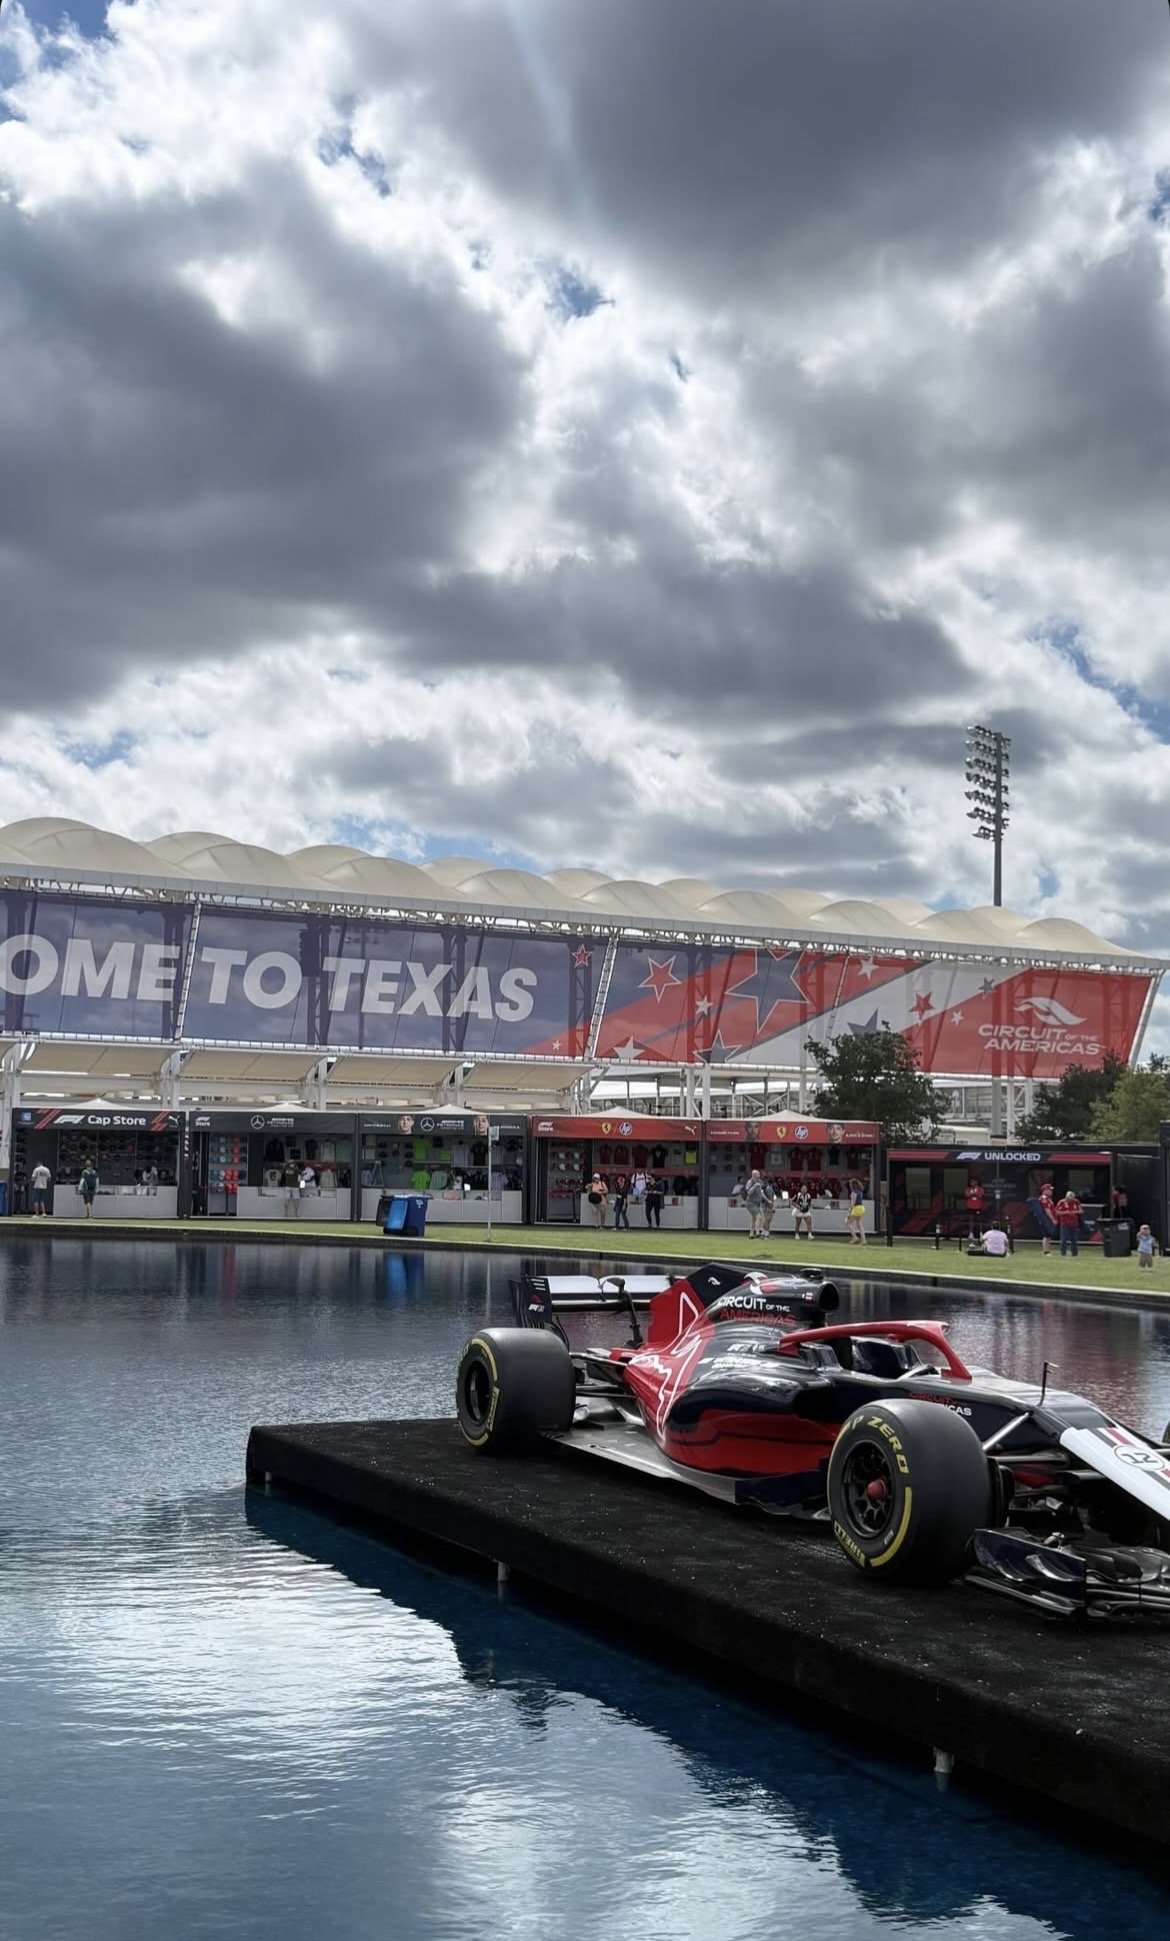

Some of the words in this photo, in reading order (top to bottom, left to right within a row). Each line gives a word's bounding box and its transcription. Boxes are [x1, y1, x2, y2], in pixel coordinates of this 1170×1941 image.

[201, 946, 303, 1009] TO
[322, 956, 538, 1022] TEXAS
[978, 1024, 1067, 1039] CIRCUIT
[984, 1038, 1101, 1055] AMERICAS
[87, 1115, 111, 1125] Cap
[113, 1115, 147, 1125] Store
[984, 1152, 1041, 1161] UNLOCKED
[717, 1296, 766, 1310] CIRCUIT
[720, 1309, 796, 1327] AMERICAS
[867, 1415, 910, 1474] ZERO
[1120, 1453, 1158, 1464] 12
